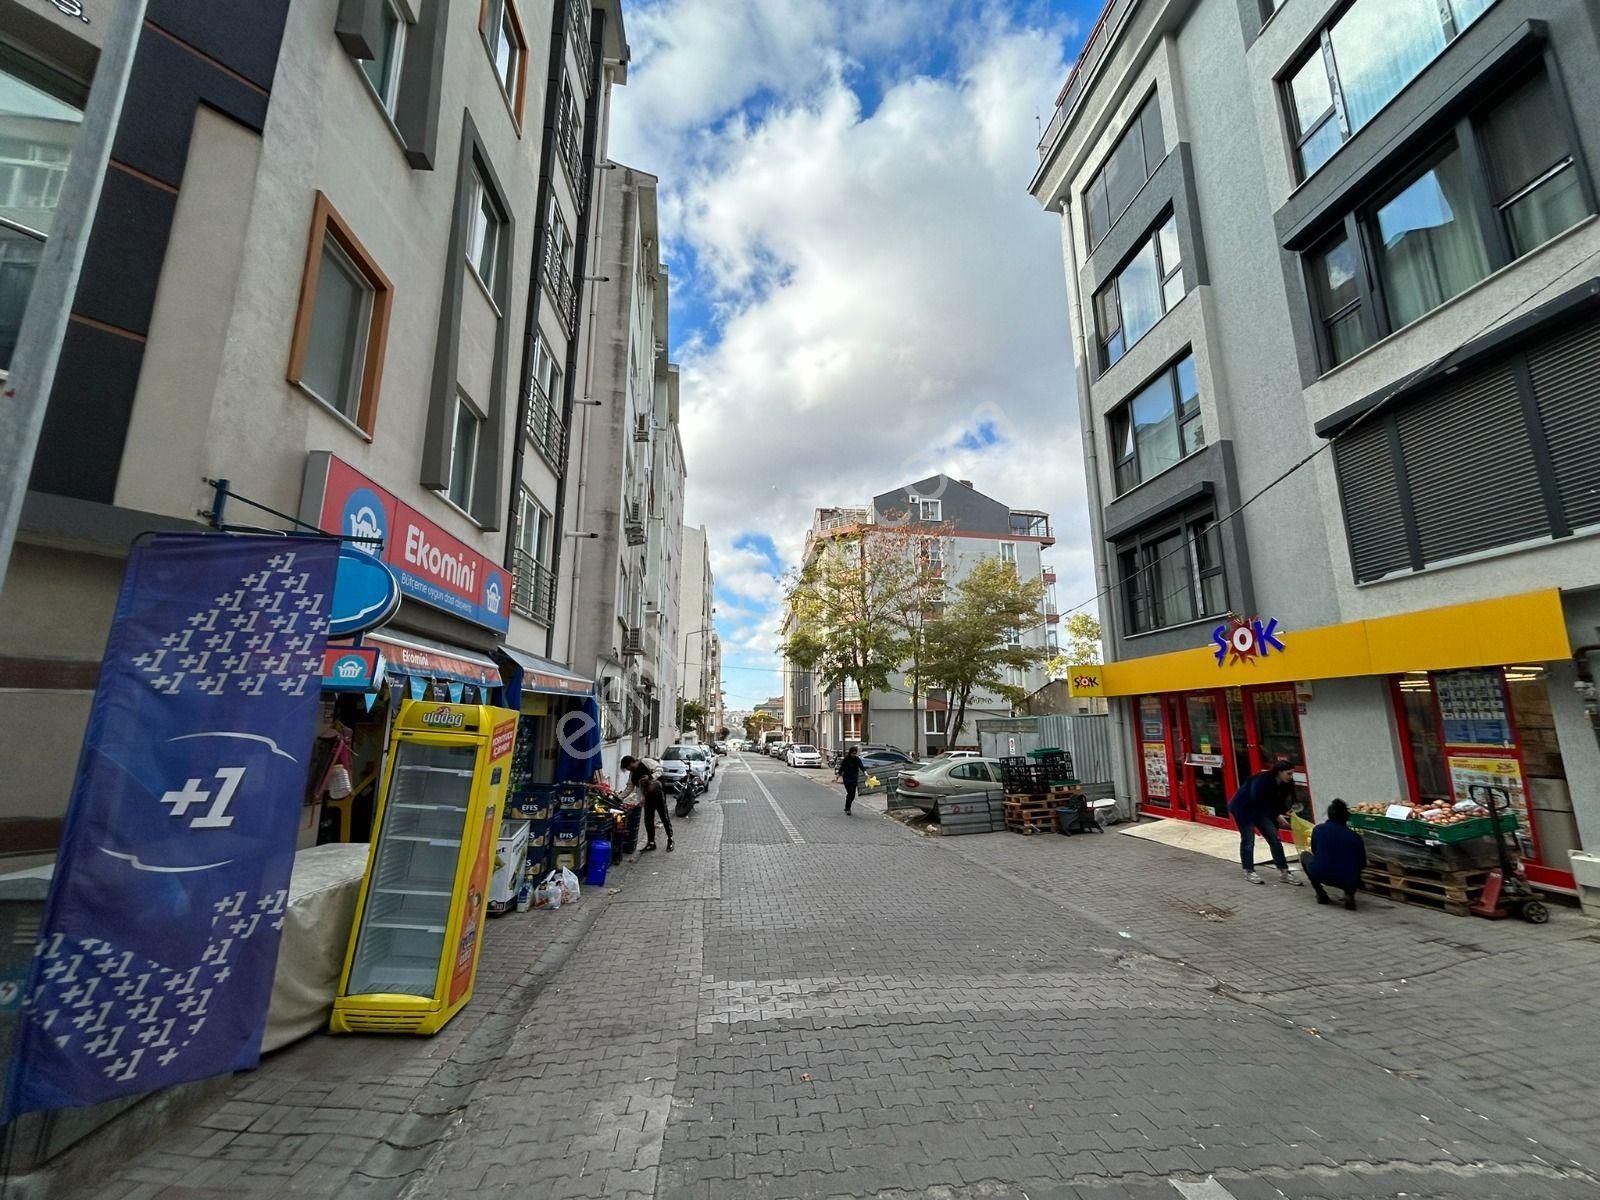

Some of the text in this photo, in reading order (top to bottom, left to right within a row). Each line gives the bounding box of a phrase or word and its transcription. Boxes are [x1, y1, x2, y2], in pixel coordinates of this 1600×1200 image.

[267, 552, 296, 573] +1
[405, 524, 476, 593] Ekomini
[242, 571, 310, 594] +1 +1
[215, 590, 324, 615] +1 +1 +1
[188, 609, 219, 631] +1
[231, 611, 260, 632] +1
[270, 612, 299, 634] +1
[161, 630, 315, 655] +1 +1 +1 +1
[132, 649, 167, 672] +1
[179, 651, 211, 673] +1
[222, 652, 251, 674] +1
[261, 653, 291, 675] +1
[402, 649, 429, 666] Ekomini
[151, 672, 309, 696] +1 +1 +1 +1
[160, 767, 246, 828] +1
[214, 891, 247, 917] +1
[43, 954, 84, 983] +1
[97, 951, 135, 978] +1
[59, 977, 100, 1008] +1
[114, 973, 151, 1001] +1
[163, 966, 201, 995] +1
[72, 1001, 113, 1032] +1
[127, 996, 162, 1024] +1
[176, 988, 213, 1016] +1
[84, 1026, 125, 1058] +1
[138, 1018, 176, 1048] +1
[104, 1048, 145, 1082] +1
